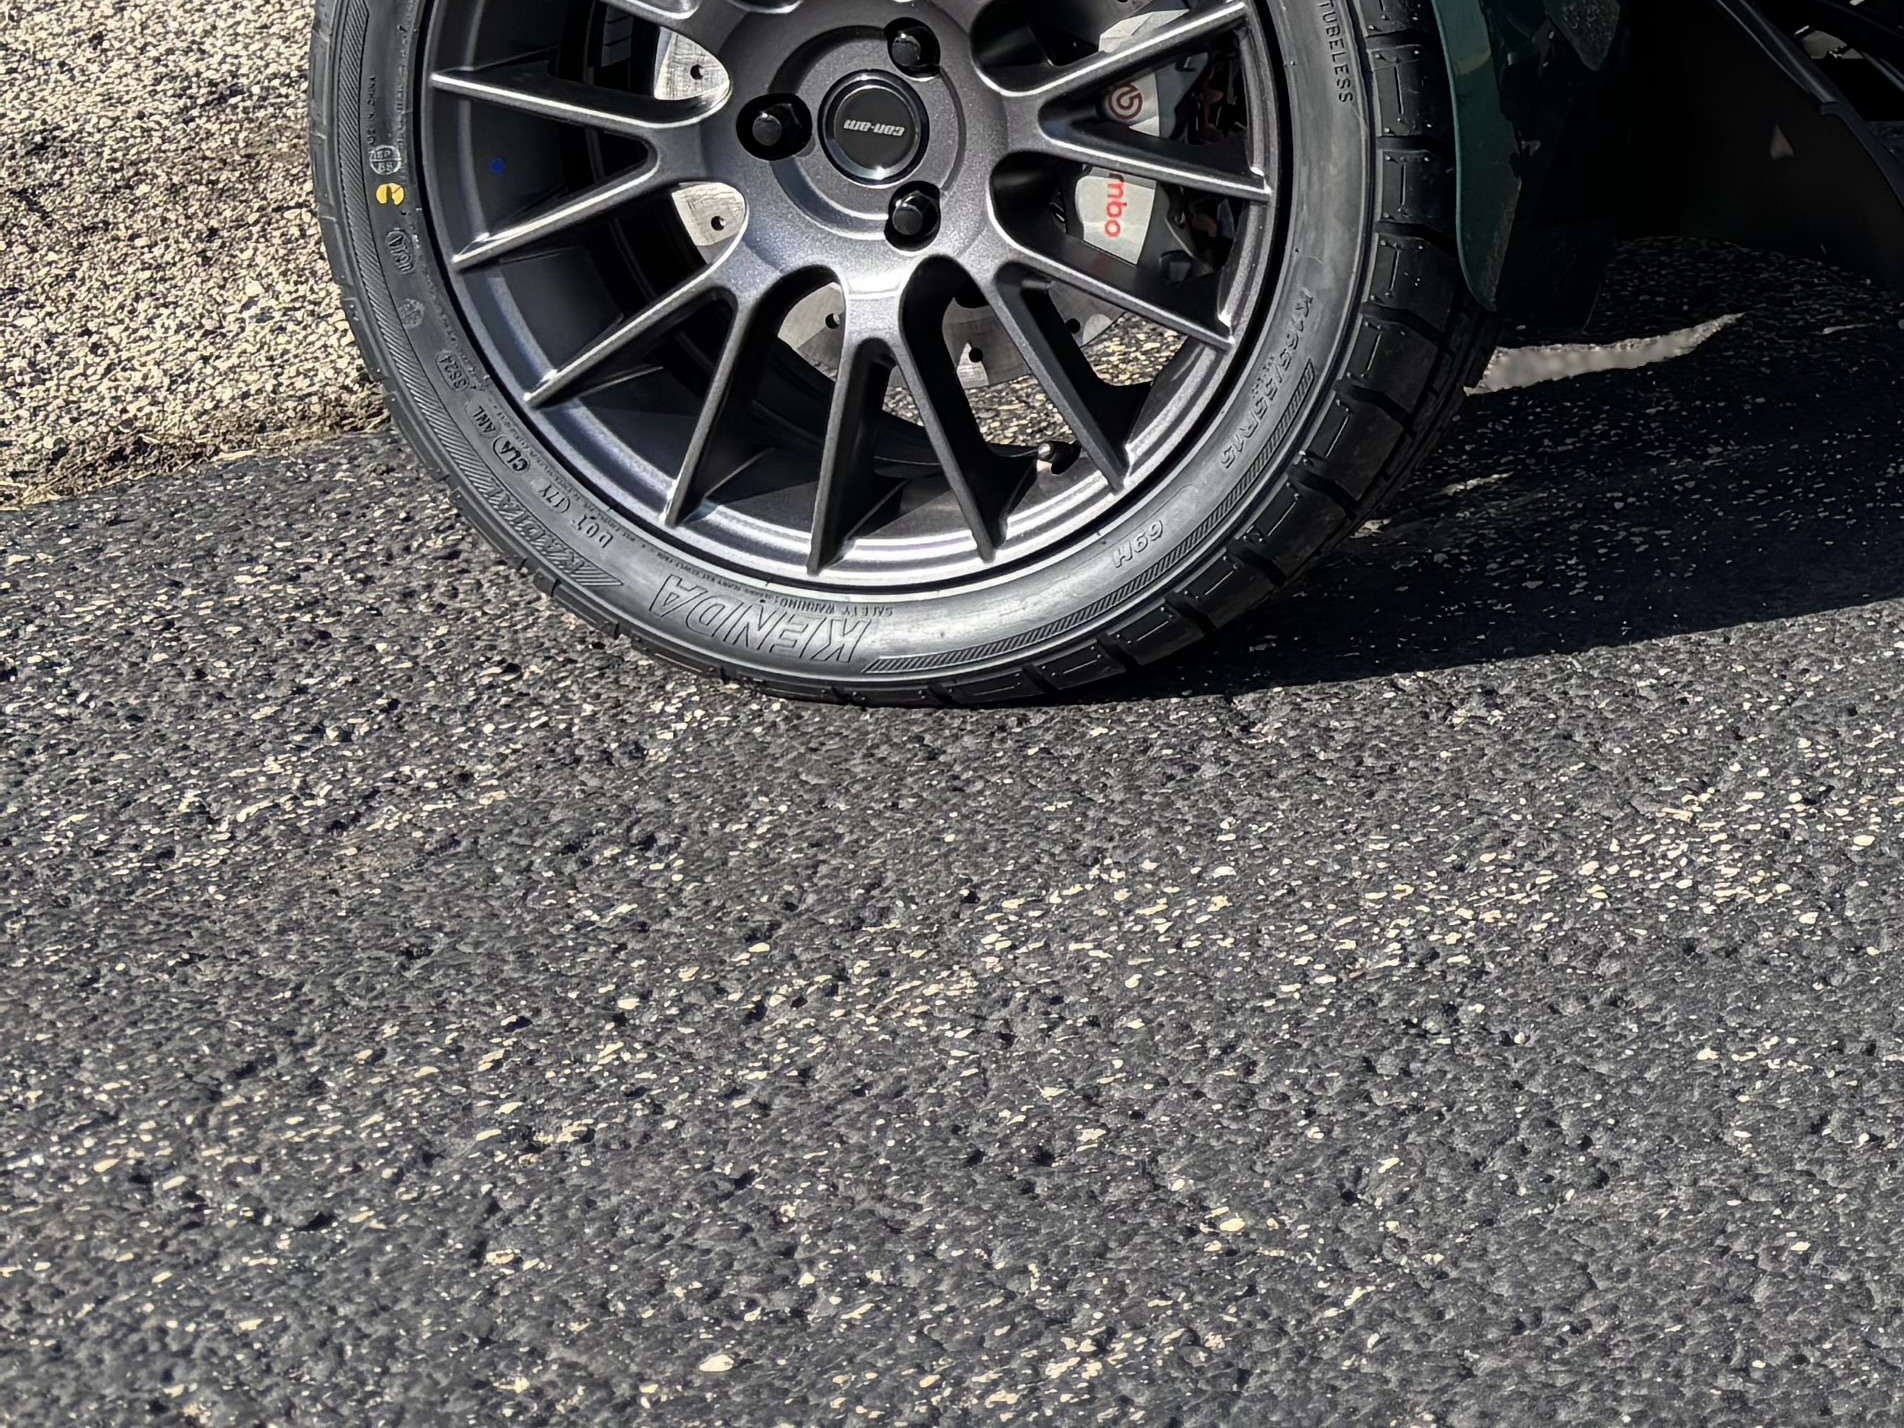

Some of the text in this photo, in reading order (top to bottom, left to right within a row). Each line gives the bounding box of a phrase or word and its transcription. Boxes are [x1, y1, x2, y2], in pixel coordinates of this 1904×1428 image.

[843, 119, 905, 137] can-am
[1104, 172, 1127, 238] mbo
[500, 438, 529, 472] CLA
[484, 486, 585, 572] RADIAL
[573, 514, 613, 549] DOT
[1112, 518, 1165, 568] 69H
[649, 573, 872, 663] KENDA
